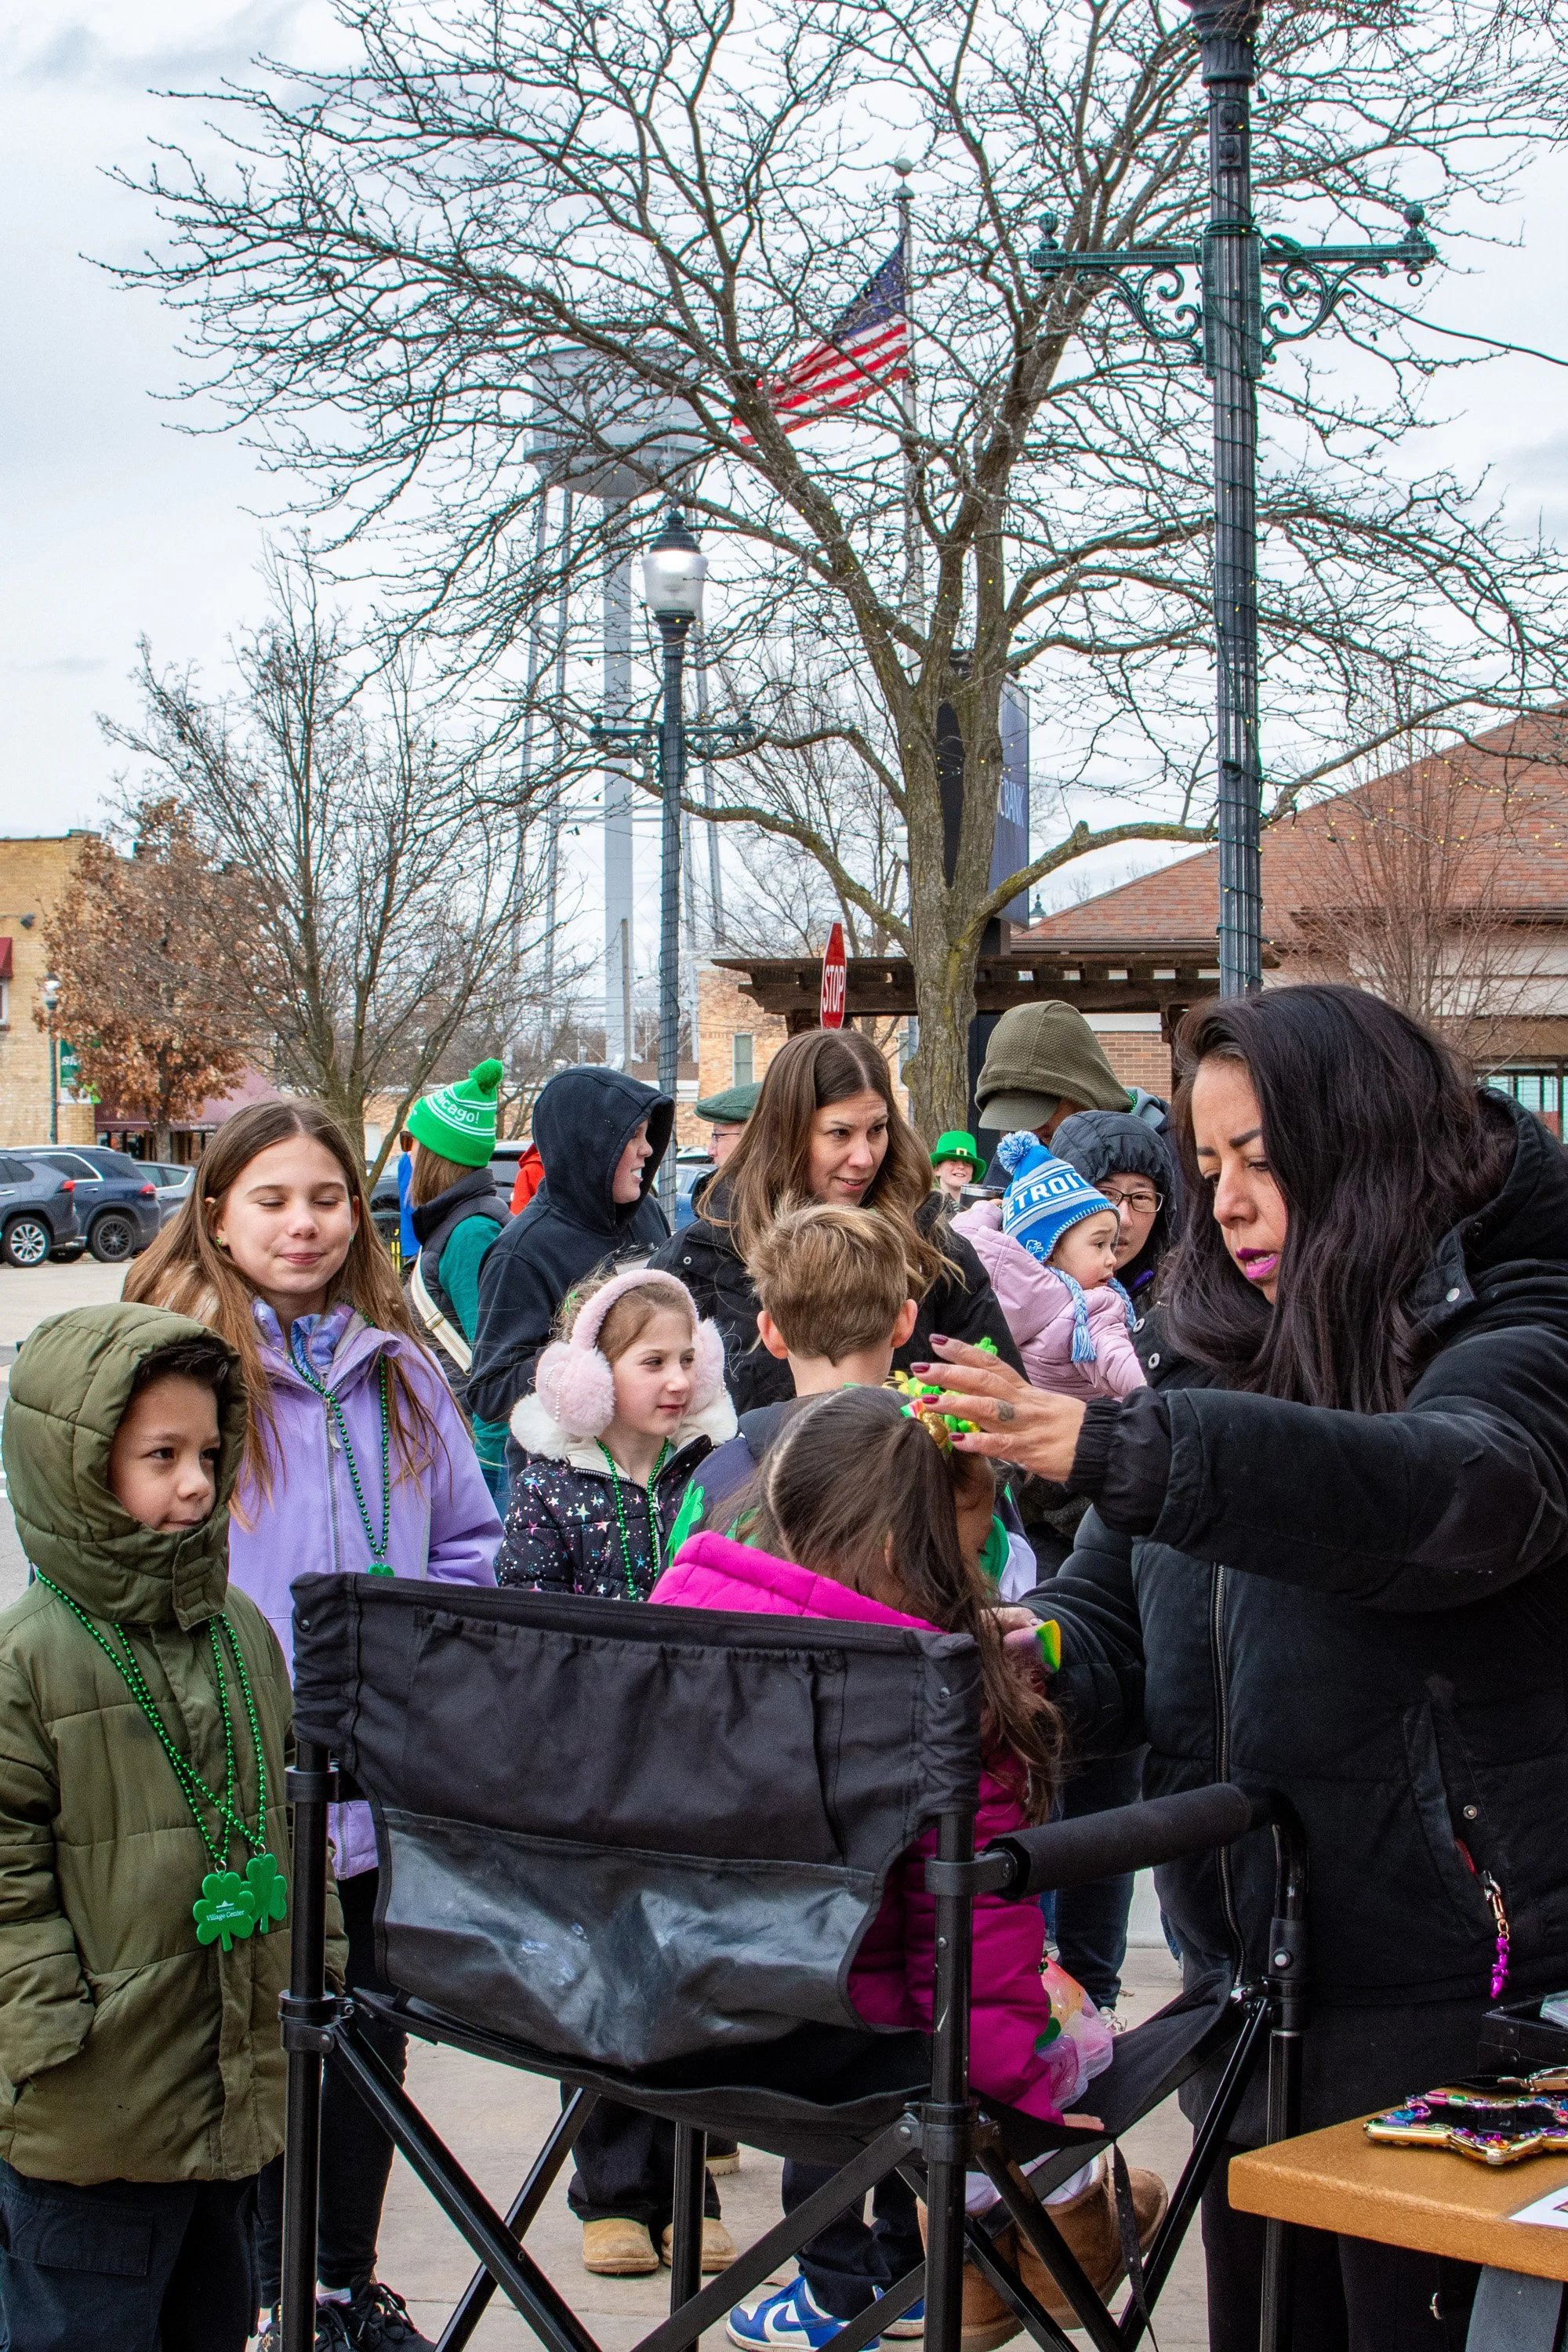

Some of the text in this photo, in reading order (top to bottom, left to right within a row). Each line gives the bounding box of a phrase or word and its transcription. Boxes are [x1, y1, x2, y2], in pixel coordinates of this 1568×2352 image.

[823, 964, 844, 1013] STOP
[435, 1091, 480, 1124] hicago!
[1004, 1172, 1089, 1223] ETROIT
[226, 1910, 245, 1918] Center
